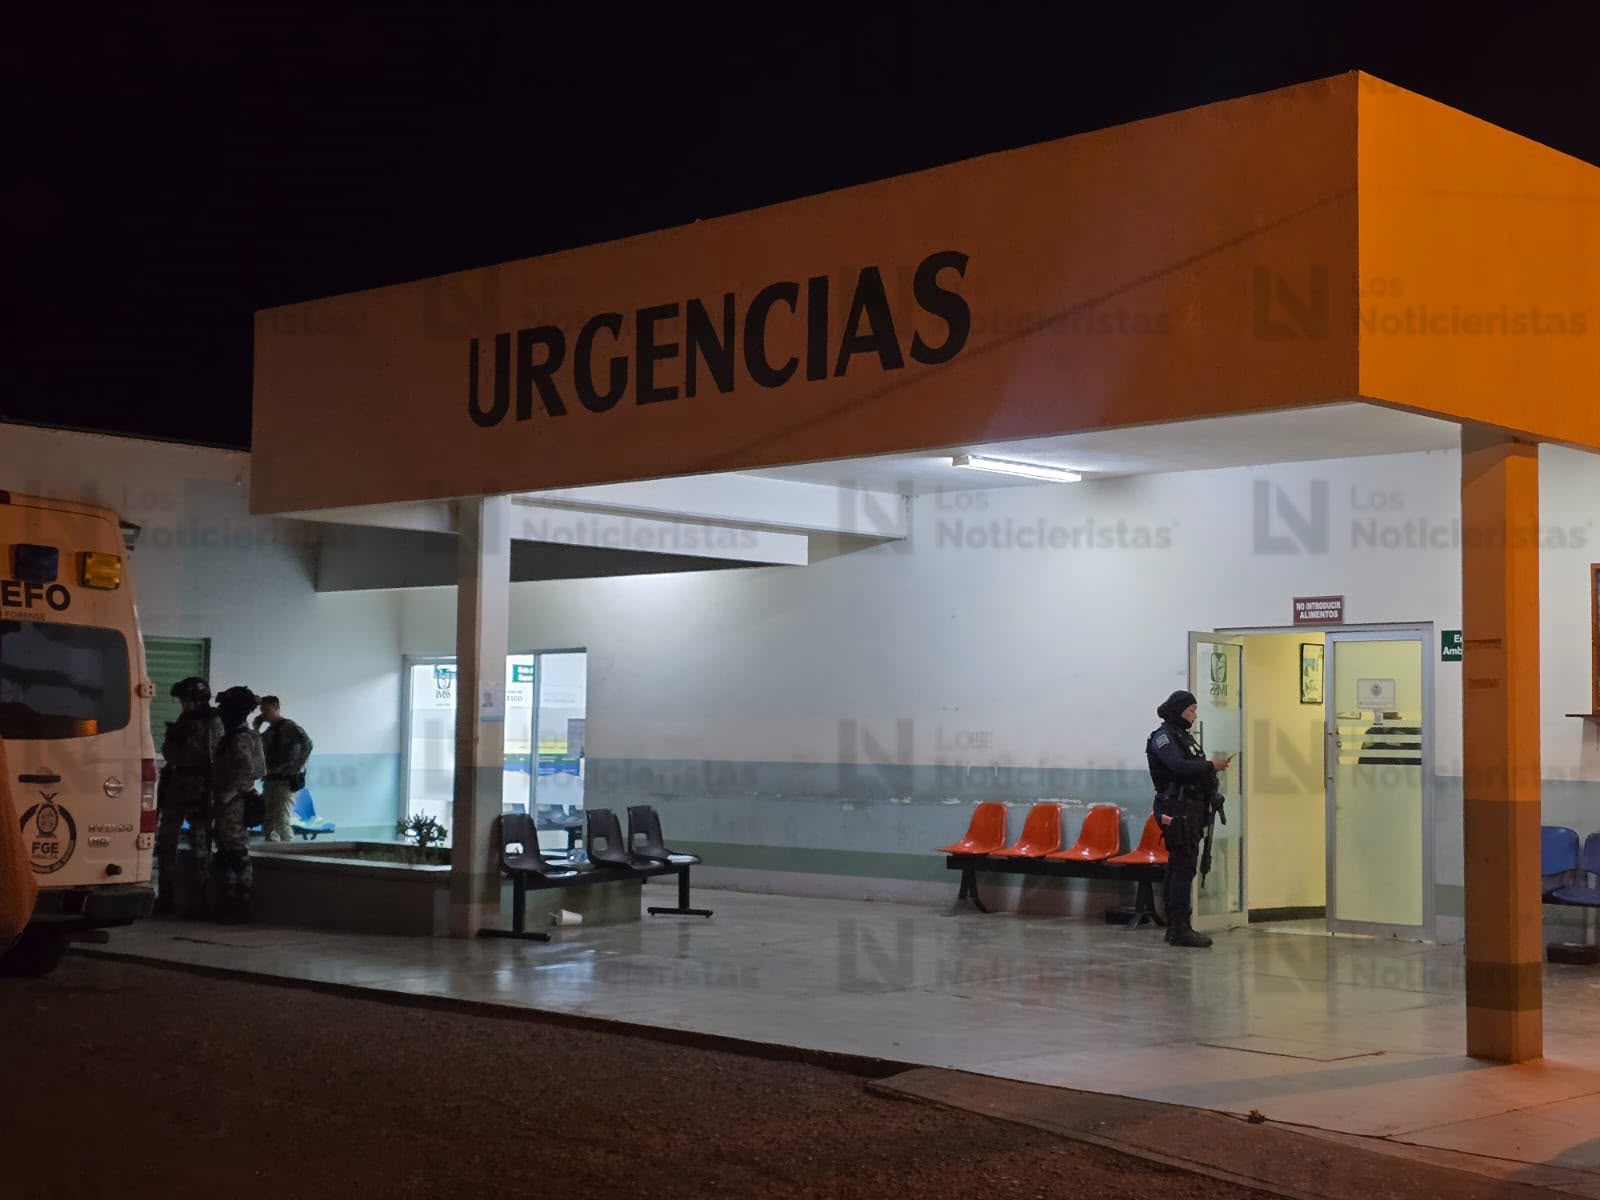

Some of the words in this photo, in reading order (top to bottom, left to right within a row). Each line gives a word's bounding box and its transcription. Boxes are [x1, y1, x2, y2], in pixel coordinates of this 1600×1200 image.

[468, 251, 971, 427] URGENCIAS
[1296, 602, 1305, 611] NO
[1306, 601, 1341, 610] INTRODUCIR
[1299, 610, 1338, 619] ALIMENTOS
[31, 841, 60, 854] FGE
